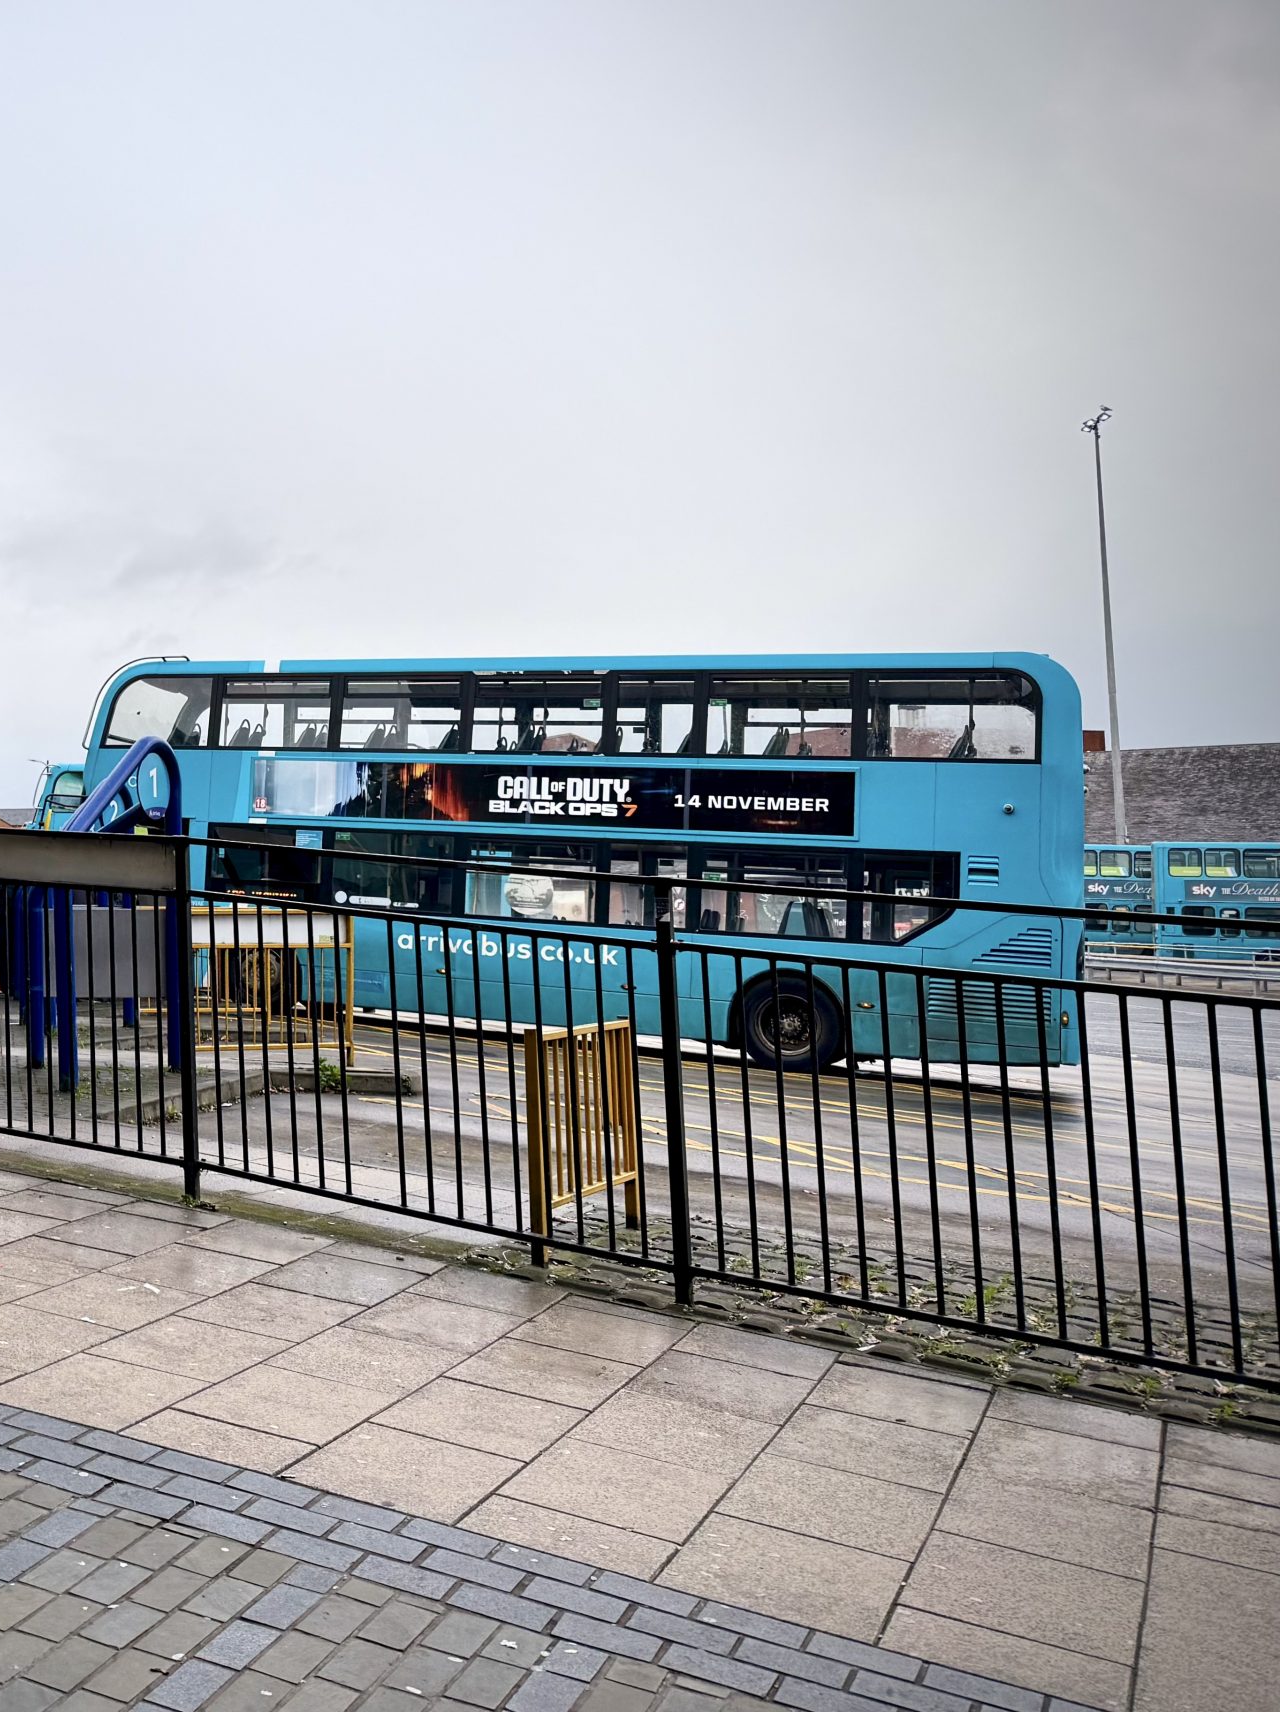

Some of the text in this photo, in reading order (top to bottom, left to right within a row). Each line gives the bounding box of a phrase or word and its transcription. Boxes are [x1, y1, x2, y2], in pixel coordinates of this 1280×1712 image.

[149, 767, 157, 798] 1
[497, 775, 553, 800] CALL
[550, 781, 566, 793] OF
[256, 798, 266, 808] 18
[488, 799, 638, 817] BLACK OPS 7
[674, 794, 830, 812] 14 NOVEMBER
[1087, 882, 1110, 895] sky
[1123, 881, 1152, 894] Dea
[1192, 884, 1217, 897] sky
